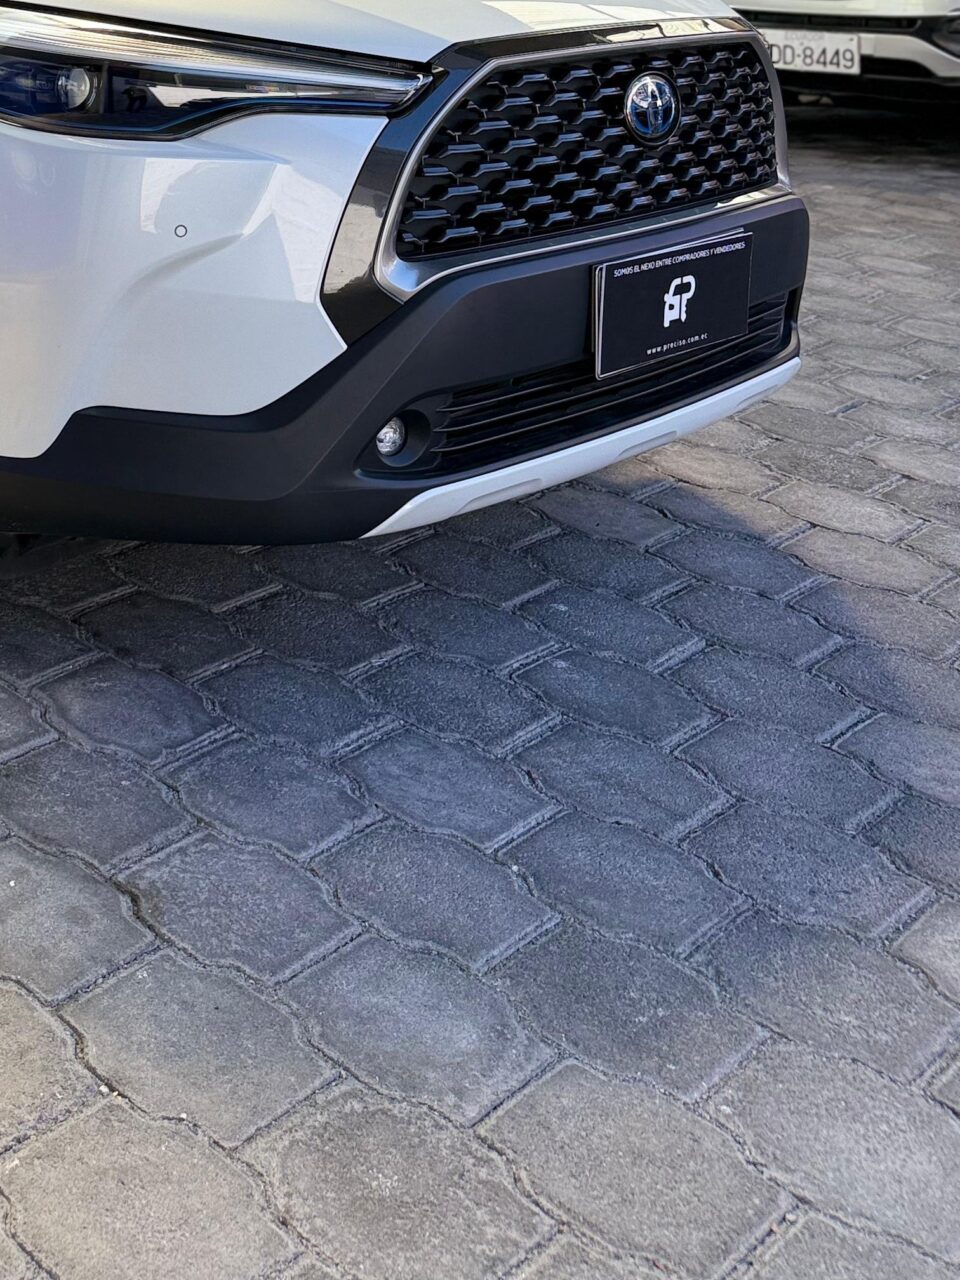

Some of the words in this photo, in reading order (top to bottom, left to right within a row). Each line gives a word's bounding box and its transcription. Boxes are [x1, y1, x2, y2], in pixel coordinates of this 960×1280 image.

[614, 266, 634, 278] SOMOS
[655, 257, 672, 268] ENTRE
[672, 249, 710, 264] COMPRADORES
[714, 241, 746, 254] VENDEDORES
[646, 332, 708, 355] www.preciso.com.ec
